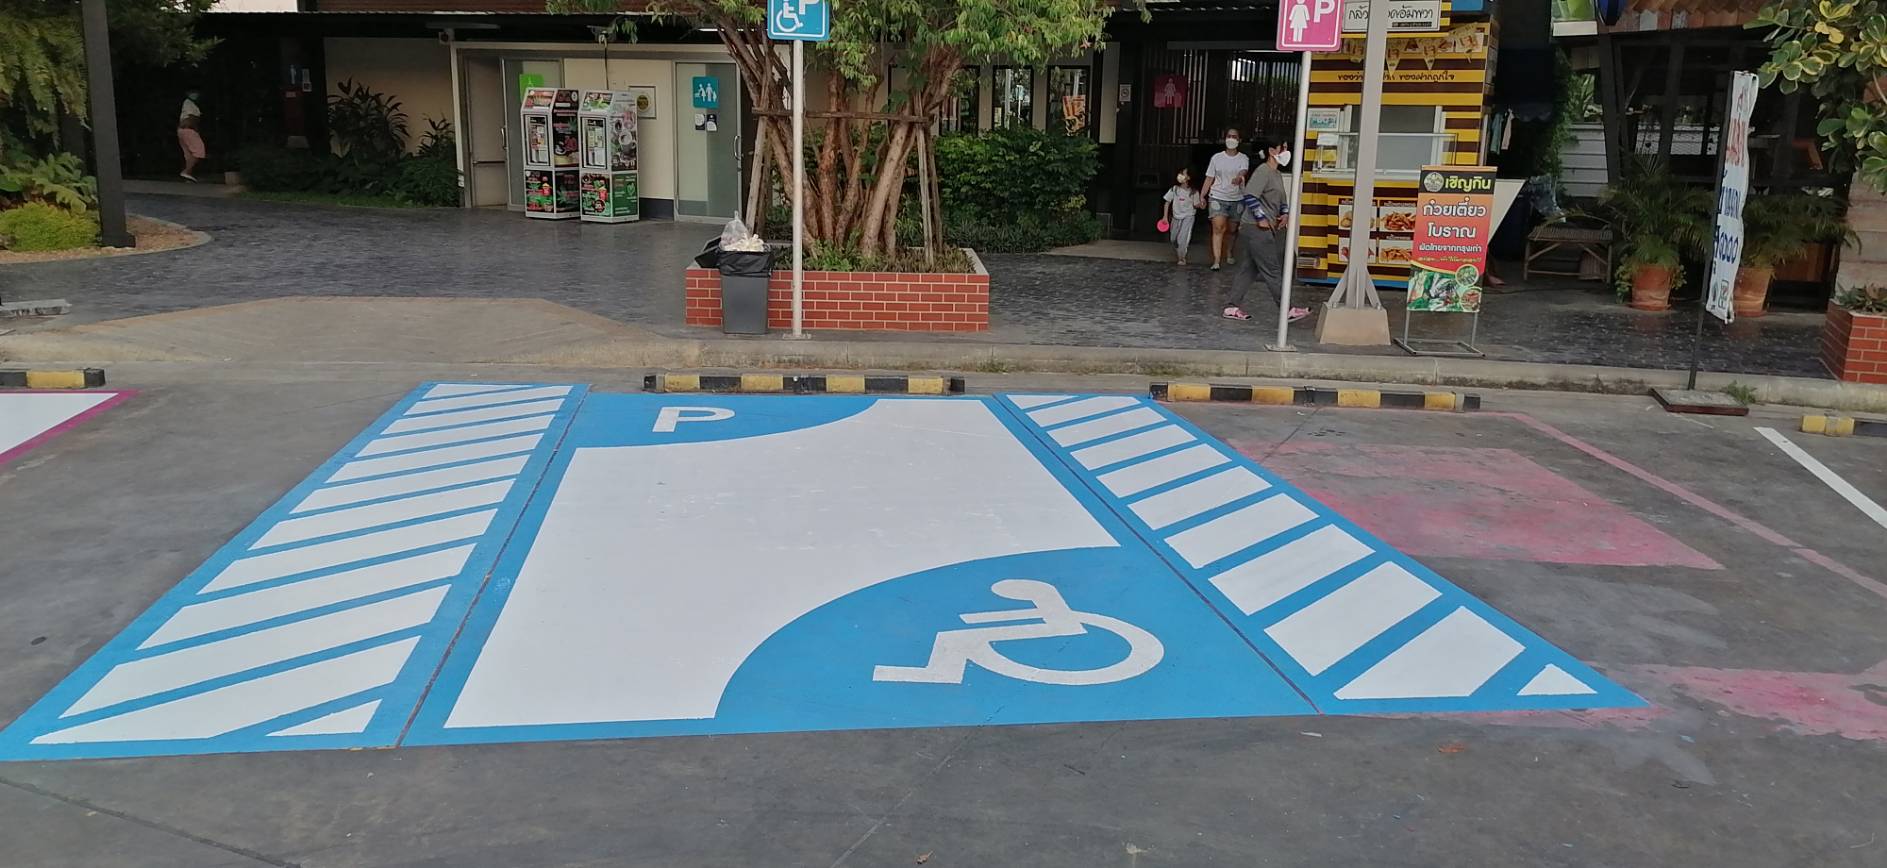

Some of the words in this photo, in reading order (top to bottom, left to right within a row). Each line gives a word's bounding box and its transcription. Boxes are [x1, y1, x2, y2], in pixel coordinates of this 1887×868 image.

[1313, 0, 1335, 23] P
[1445, 175, 1491, 192] เชิญกิน
[1427, 222, 1476, 238] โบราณ
[652, 406, 735, 433] P
